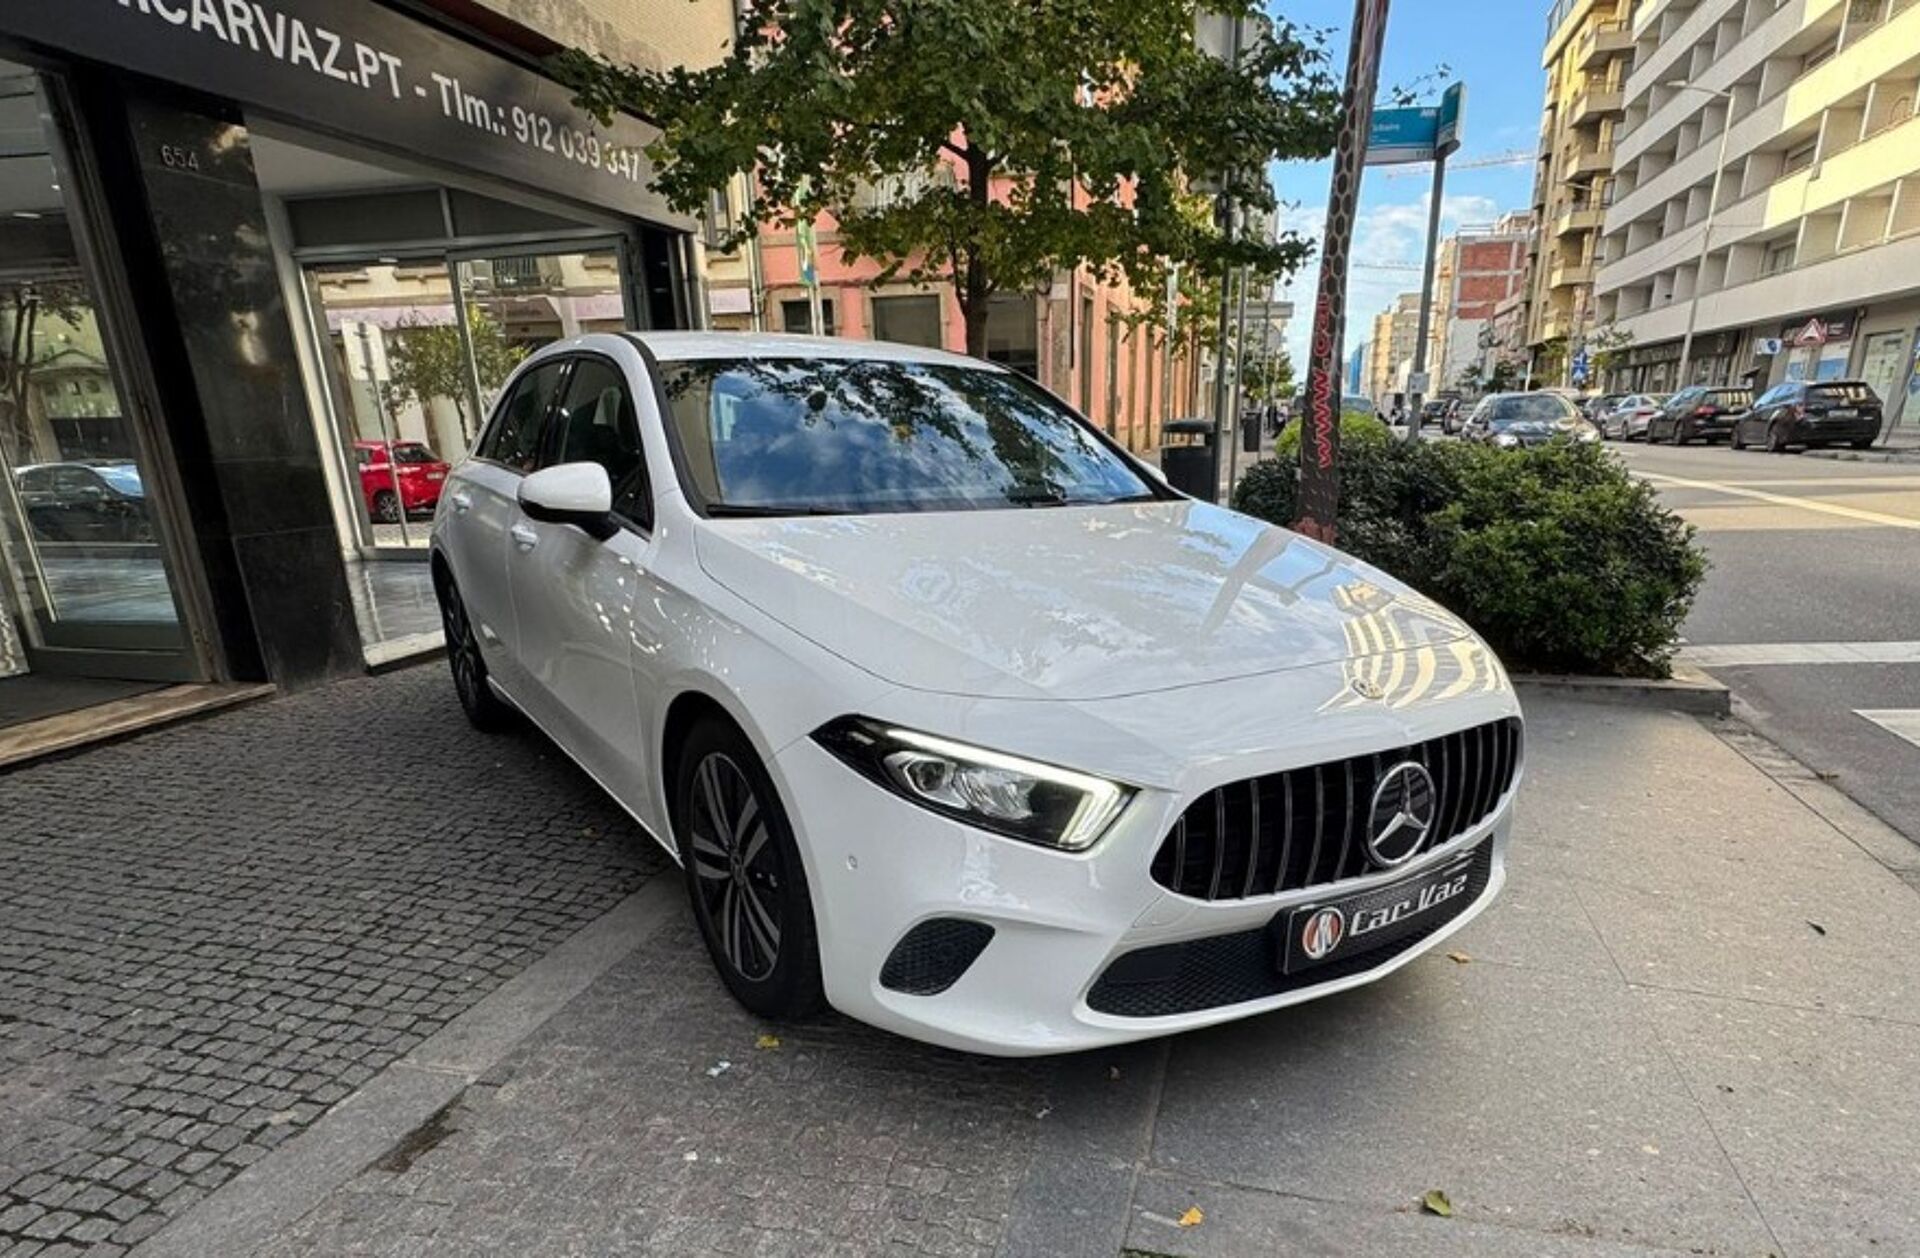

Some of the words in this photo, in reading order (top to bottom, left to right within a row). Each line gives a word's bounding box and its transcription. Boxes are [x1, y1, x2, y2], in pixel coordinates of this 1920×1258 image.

[117, 0, 402, 98] CARVAZ.PT
[431, 71, 507, 137] Tlm.:
[512, 106, 555, 154] 912
[560, 125, 601, 169] 039
[604, 142, 639, 182] 347
[161, 145, 199, 171] 654
[1349, 899, 1412, 936] Car
